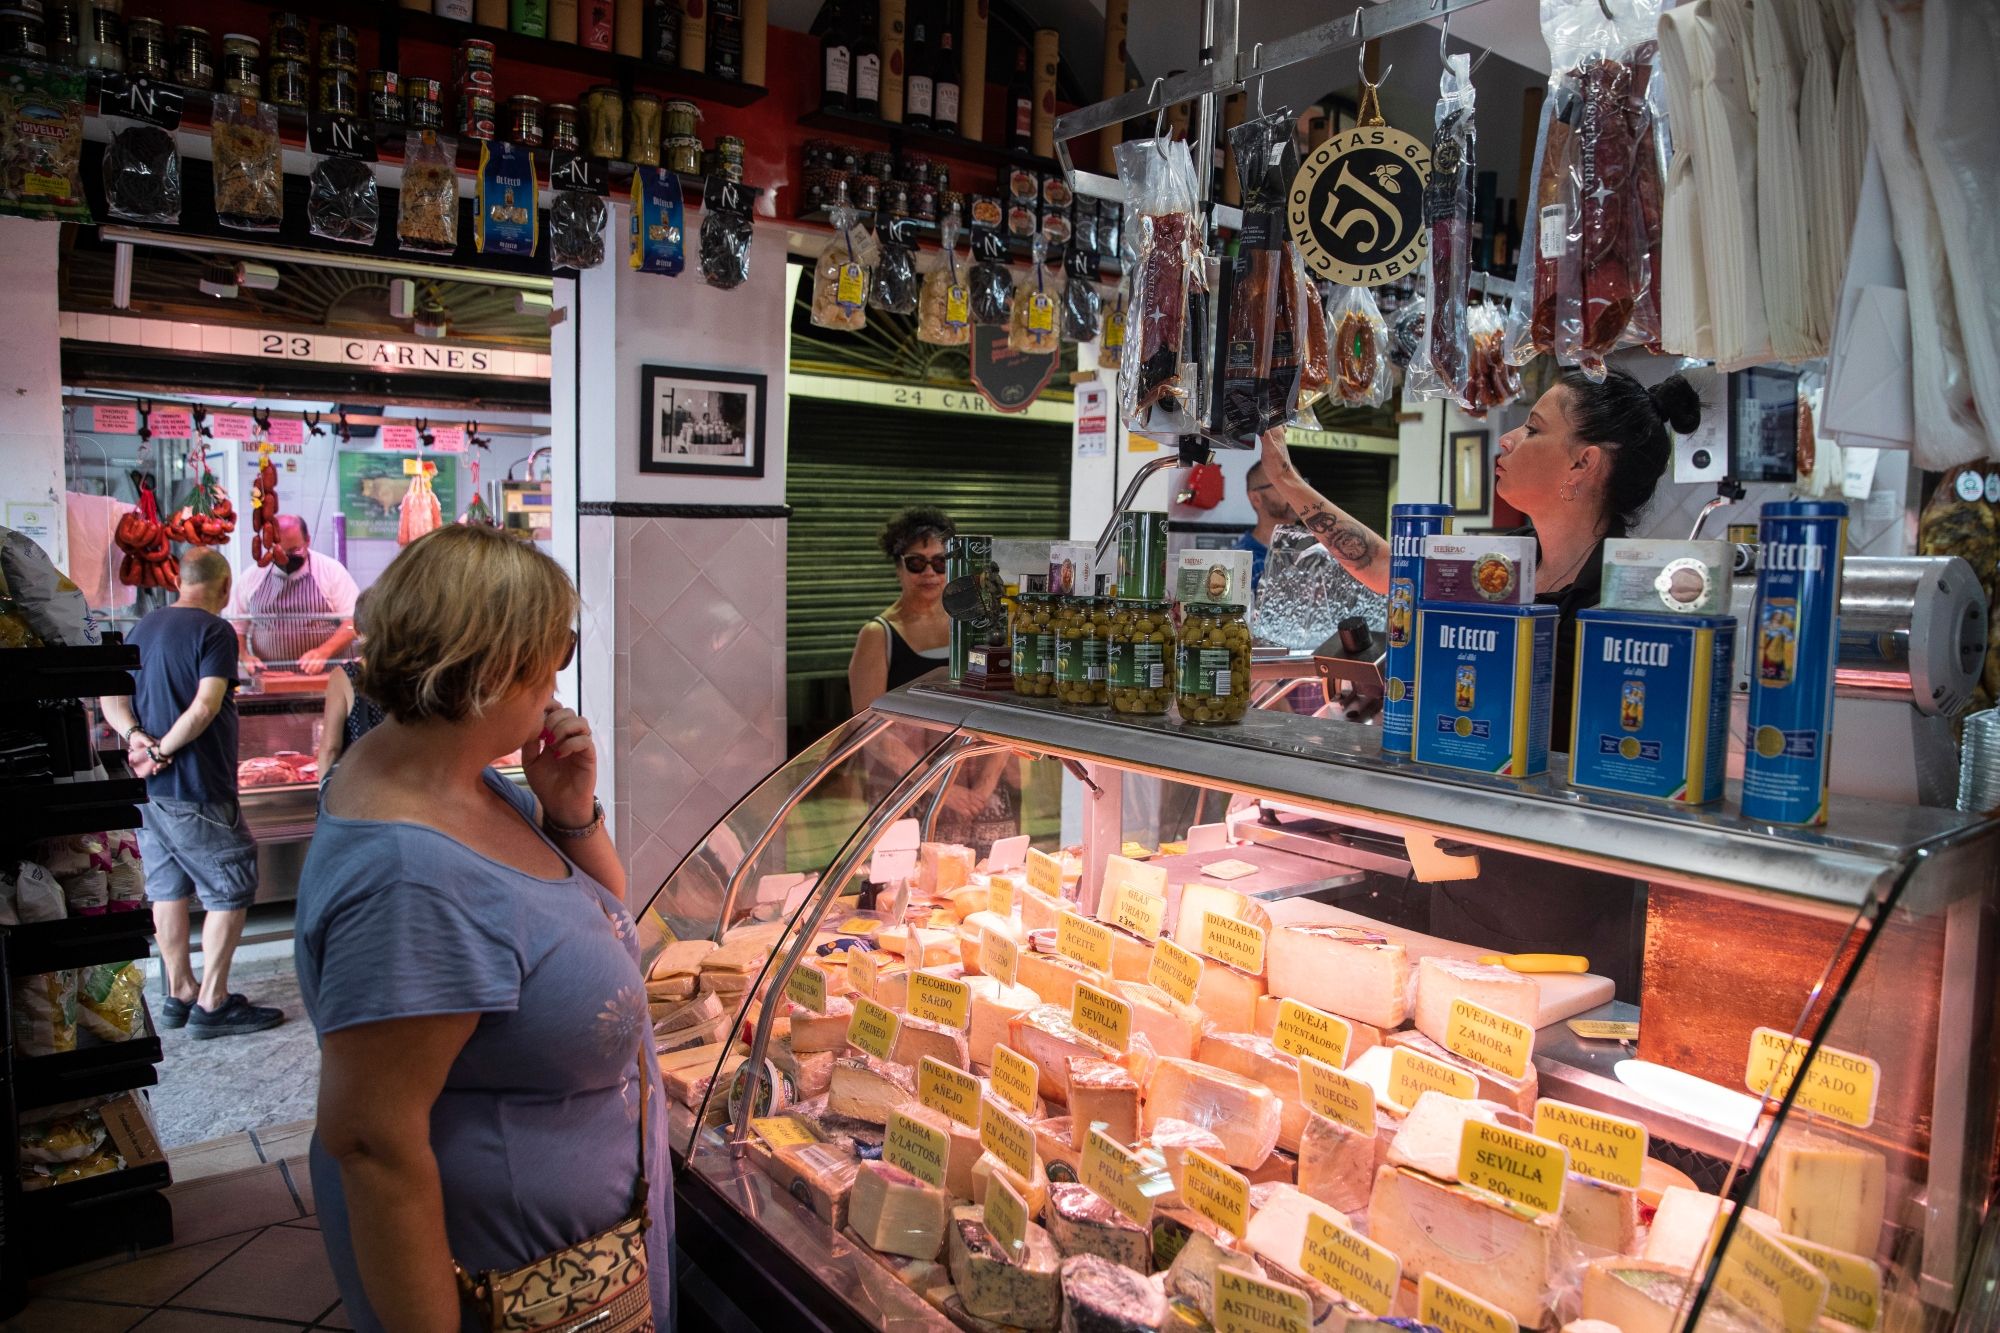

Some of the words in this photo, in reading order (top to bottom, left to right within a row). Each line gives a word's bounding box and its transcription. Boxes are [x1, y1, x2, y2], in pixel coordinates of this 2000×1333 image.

[22, 121, 65, 138] DIVELLA
[1304, 131, 1385, 179] JOTAS
[1292, 189, 1332, 271] CINCO
[1146, 254, 1158, 312] NTESIERRA
[263, 334, 311, 357] 23
[345, 342, 488, 371] CARNES
[894, 387, 923, 405] 24
[1440, 625, 1456, 649] DE
[1457, 626, 1496, 652] CECCO
[1603, 636, 1622, 662] DE
[1624, 638, 1670, 667] CECCO
[1127, 889, 1150, 905] GRAN
[1120, 901, 1151, 922] VIRIATO
[1207, 913, 1261, 941] IDIAZABAL
[1065, 932, 1096, 952] ACEITE
[1164, 945, 1188, 967] CABRA
[1208, 931, 1255, 956] AHUMADO
[915, 974, 962, 995] PECORINO
[865, 1004, 888, 1024] CABRA
[920, 993, 953, 1010] SARDO
[1079, 987, 1123, 1015] PIMENTON
[859, 1019, 886, 1040] PIRINEO
[1081, 1006, 1118, 1031] SEVILLA
[1293, 1009, 1329, 1032] OVEJA
[1456, 1004, 1498, 1029] OVEJA
[1458, 1025, 1513, 1057] ZAMORA
[923, 1061, 954, 1083] OVEJA
[956, 1075, 976, 1092] RON
[994, 1067, 1031, 1097] ECOLOGICO
[1312, 1065, 1351, 1090] OVEJA
[1406, 1057, 1457, 1087] GARCIA
[932, 1083, 963, 1105] AÑEJO
[1314, 1083, 1359, 1111] NUECES
[898, 1117, 932, 1142] CABRA
[1542, 1105, 1637, 1142] MANCHEGO
[889, 1130, 942, 1168] S/LACTOSA
[985, 1121, 997, 1136] EN
[999, 1132, 1029, 1162] ACEITE
[1089, 1132, 1097, 1146] 3
[1480, 1127, 1548, 1159] ROMERO
[1557, 1132, 1619, 1160] GALAN
[1098, 1161, 1125, 1186] PRIA
[1188, 1155, 1221, 1181] OVEJA
[1223, 1176, 1243, 1194] DOS
[1476, 1150, 1545, 1185] SEVILLA
[1188, 1175, 1242, 1216] HERMANAS
[1322, 1223, 1372, 1262] CABRA
[1221, 1273, 1243, 1293] LA
[1246, 1280, 1298, 1310] PERAL
[1222, 1297, 1299, 1333] ASTURIAS
[1435, 1285, 1497, 1330] PAYOYA
